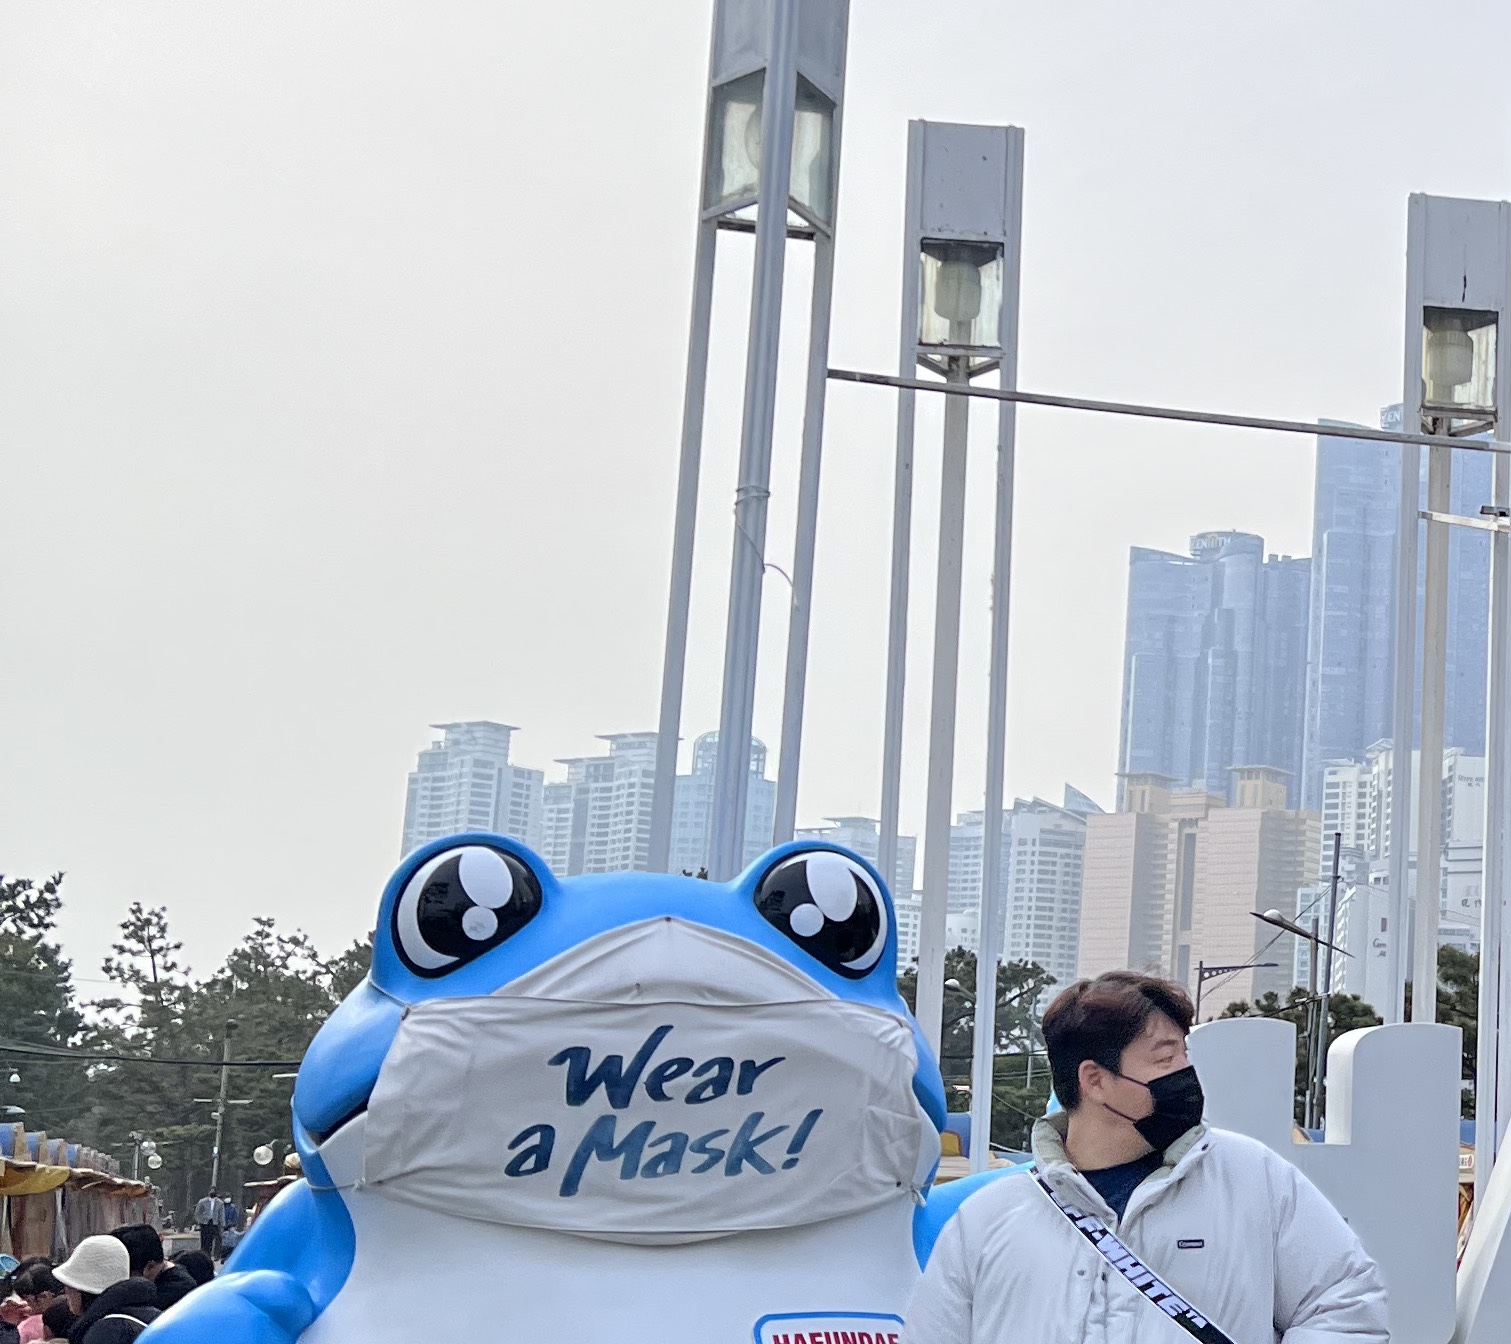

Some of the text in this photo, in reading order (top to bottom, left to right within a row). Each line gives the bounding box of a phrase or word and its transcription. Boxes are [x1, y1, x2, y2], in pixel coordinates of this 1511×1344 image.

[547, 1023, 787, 1110] Wear
[503, 1107, 825, 1198] a Mask!
